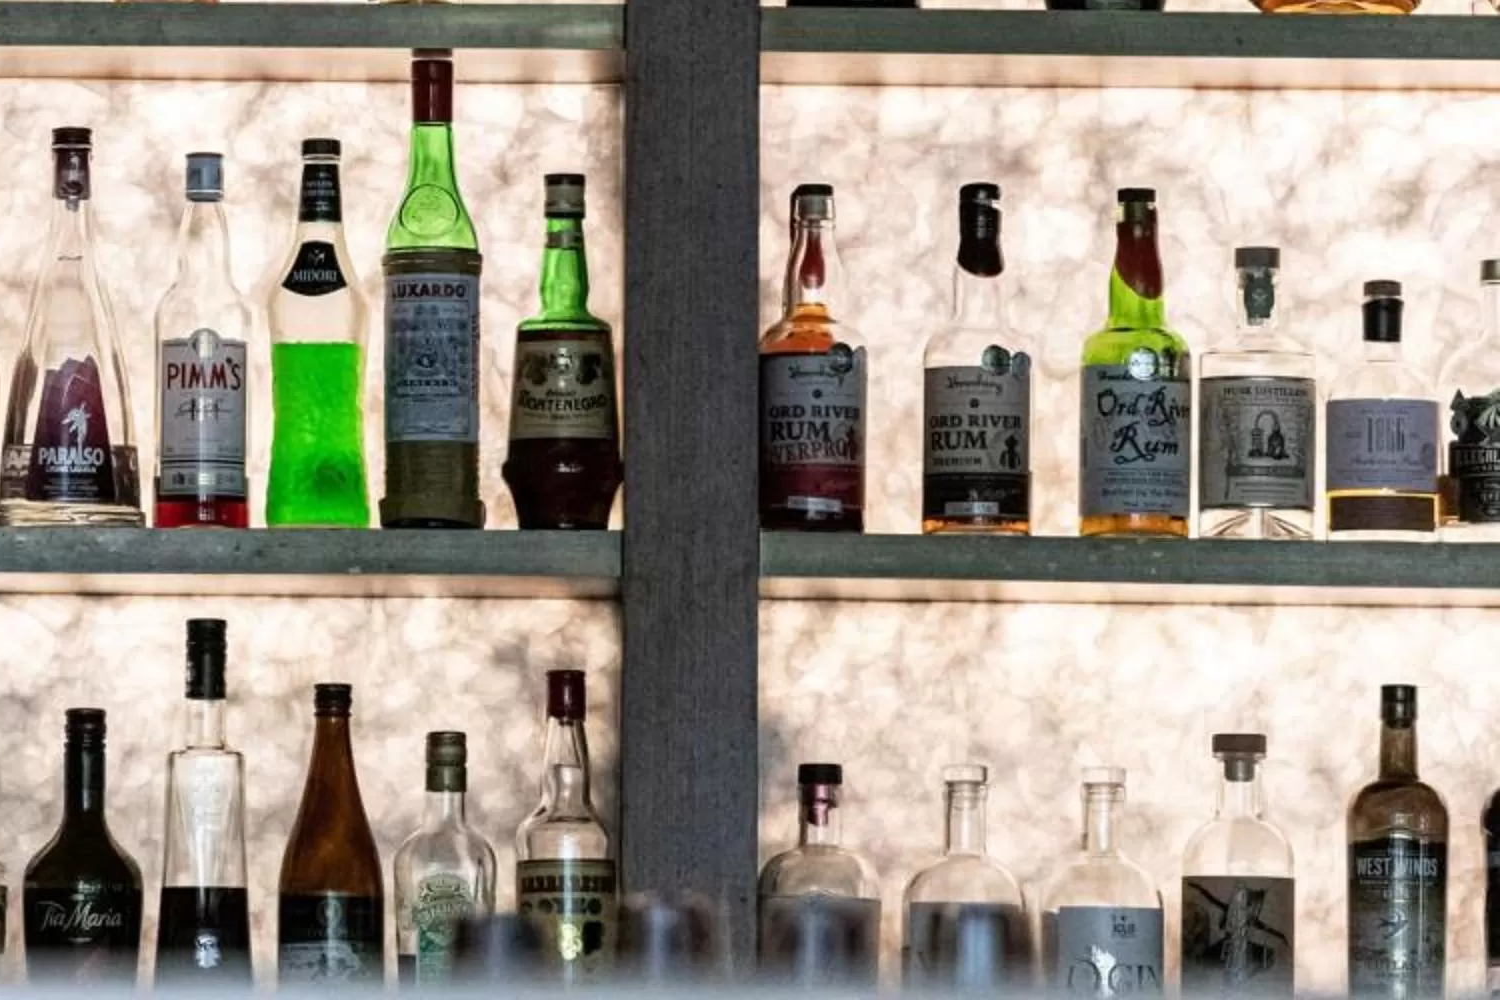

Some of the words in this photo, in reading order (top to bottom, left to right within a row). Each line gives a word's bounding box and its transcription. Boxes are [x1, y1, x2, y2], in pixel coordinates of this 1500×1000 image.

[292, 269, 339, 283] MIDORI
[166, 357, 242, 391] PIMM'S
[769, 420, 831, 442] RUM
[967, 414, 1022, 430] RIVER
[931, 430, 989, 452] RUM
[1356, 856, 1392, 877] WEST
[1393, 856, 1438, 877] WINDS
[36, 899, 66, 931] Tia
[61, 899, 123, 931] Maria
